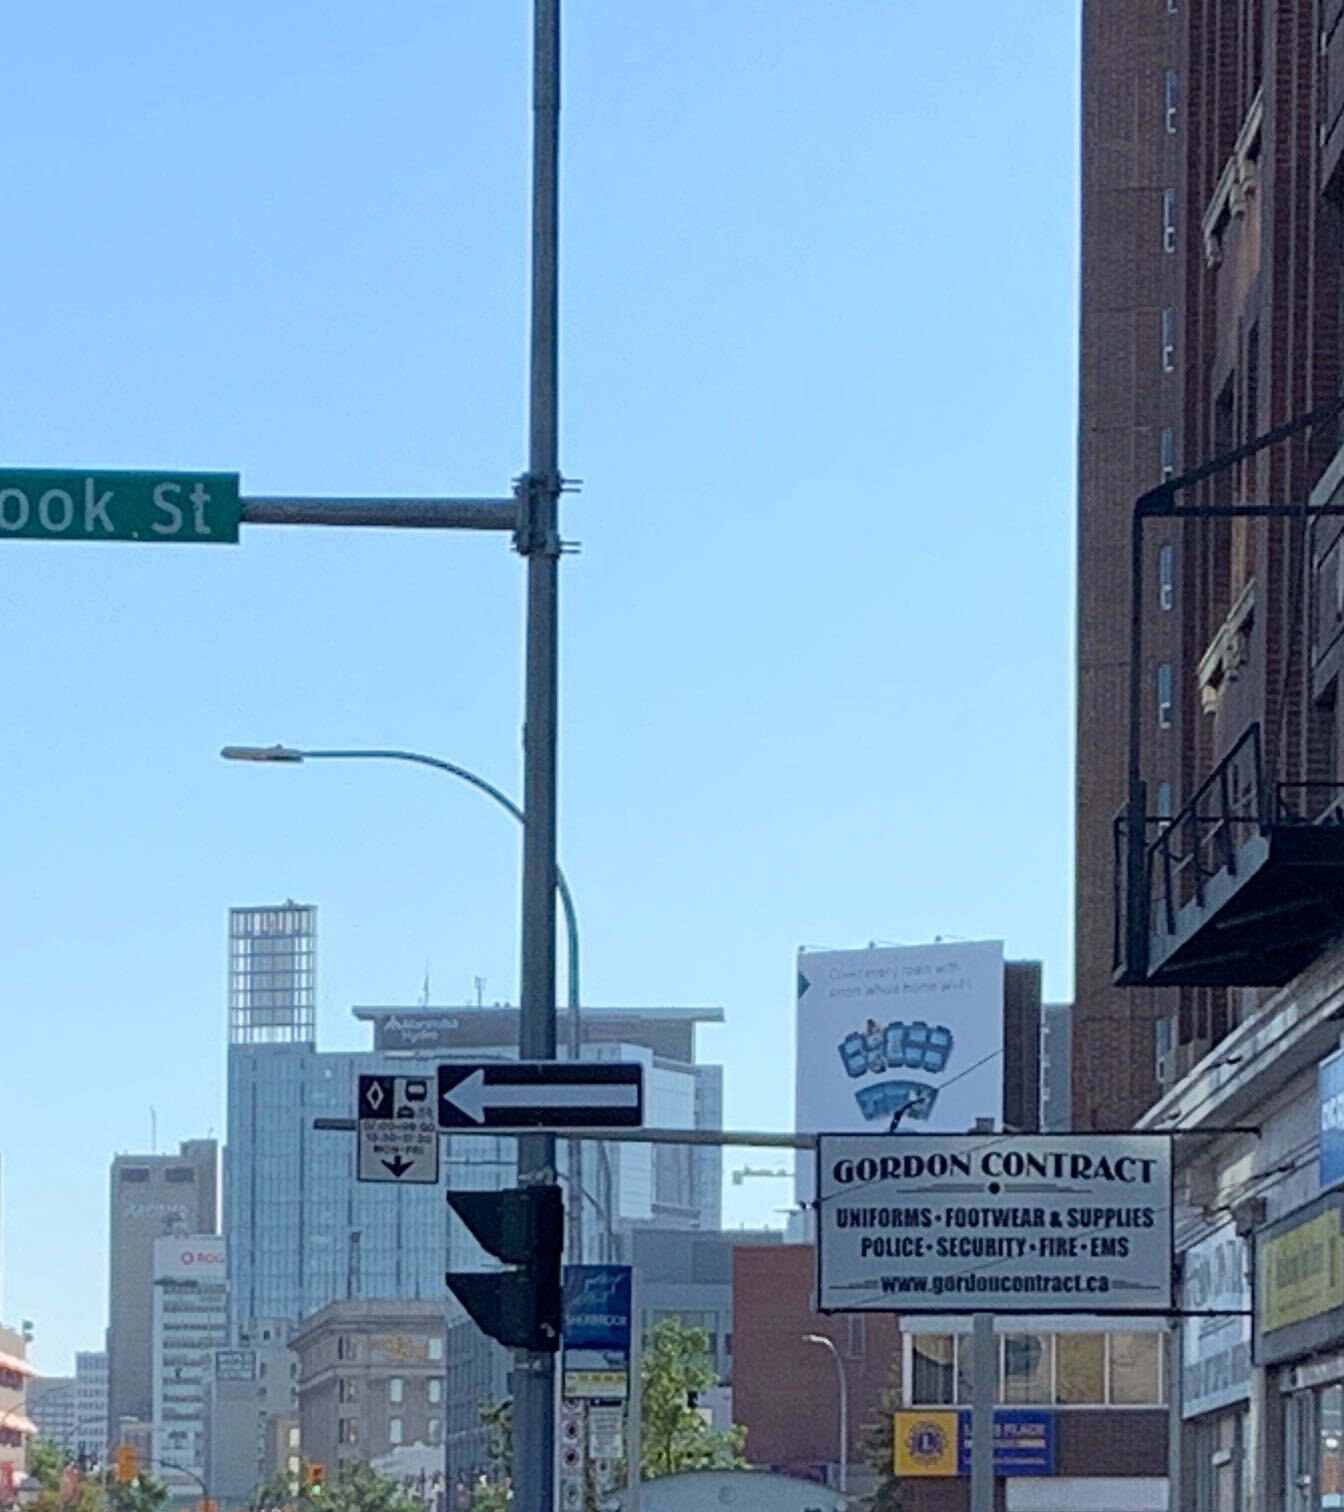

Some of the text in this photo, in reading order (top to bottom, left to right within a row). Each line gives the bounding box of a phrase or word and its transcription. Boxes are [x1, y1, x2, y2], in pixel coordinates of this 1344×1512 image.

[151, 481, 212, 535] St
[833, 1151, 1158, 1184] GORDON CONTRACT
[836, 1207, 1155, 1229] UNIFORMS FOOTWEAR & SUPPLIES
[861, 1237, 1130, 1258] POLICE SECURITY FIRE EMS
[880, 1273, 1110, 1295] www.gordoncontract.ca
